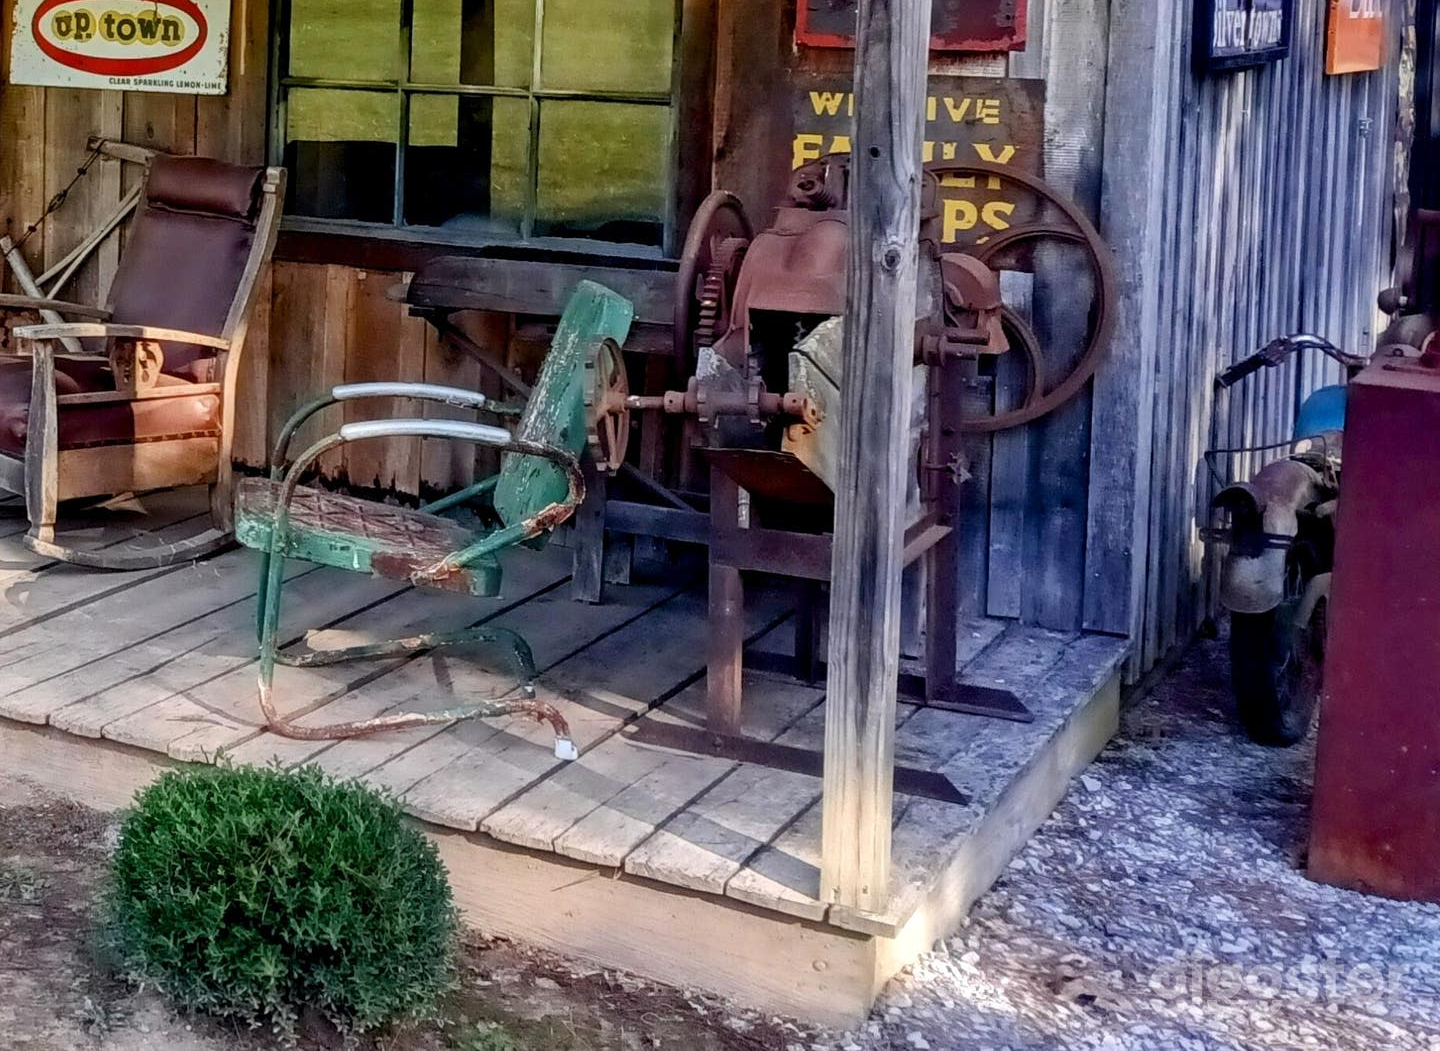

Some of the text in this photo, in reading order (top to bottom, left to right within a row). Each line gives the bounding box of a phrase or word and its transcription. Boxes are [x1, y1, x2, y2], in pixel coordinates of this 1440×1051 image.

[104, 13, 181, 41] town
[109, 77, 131, 85] CLEAR
[133, 78, 174, 88] SPARKLING
[926, 96, 1000, 124] IVE
